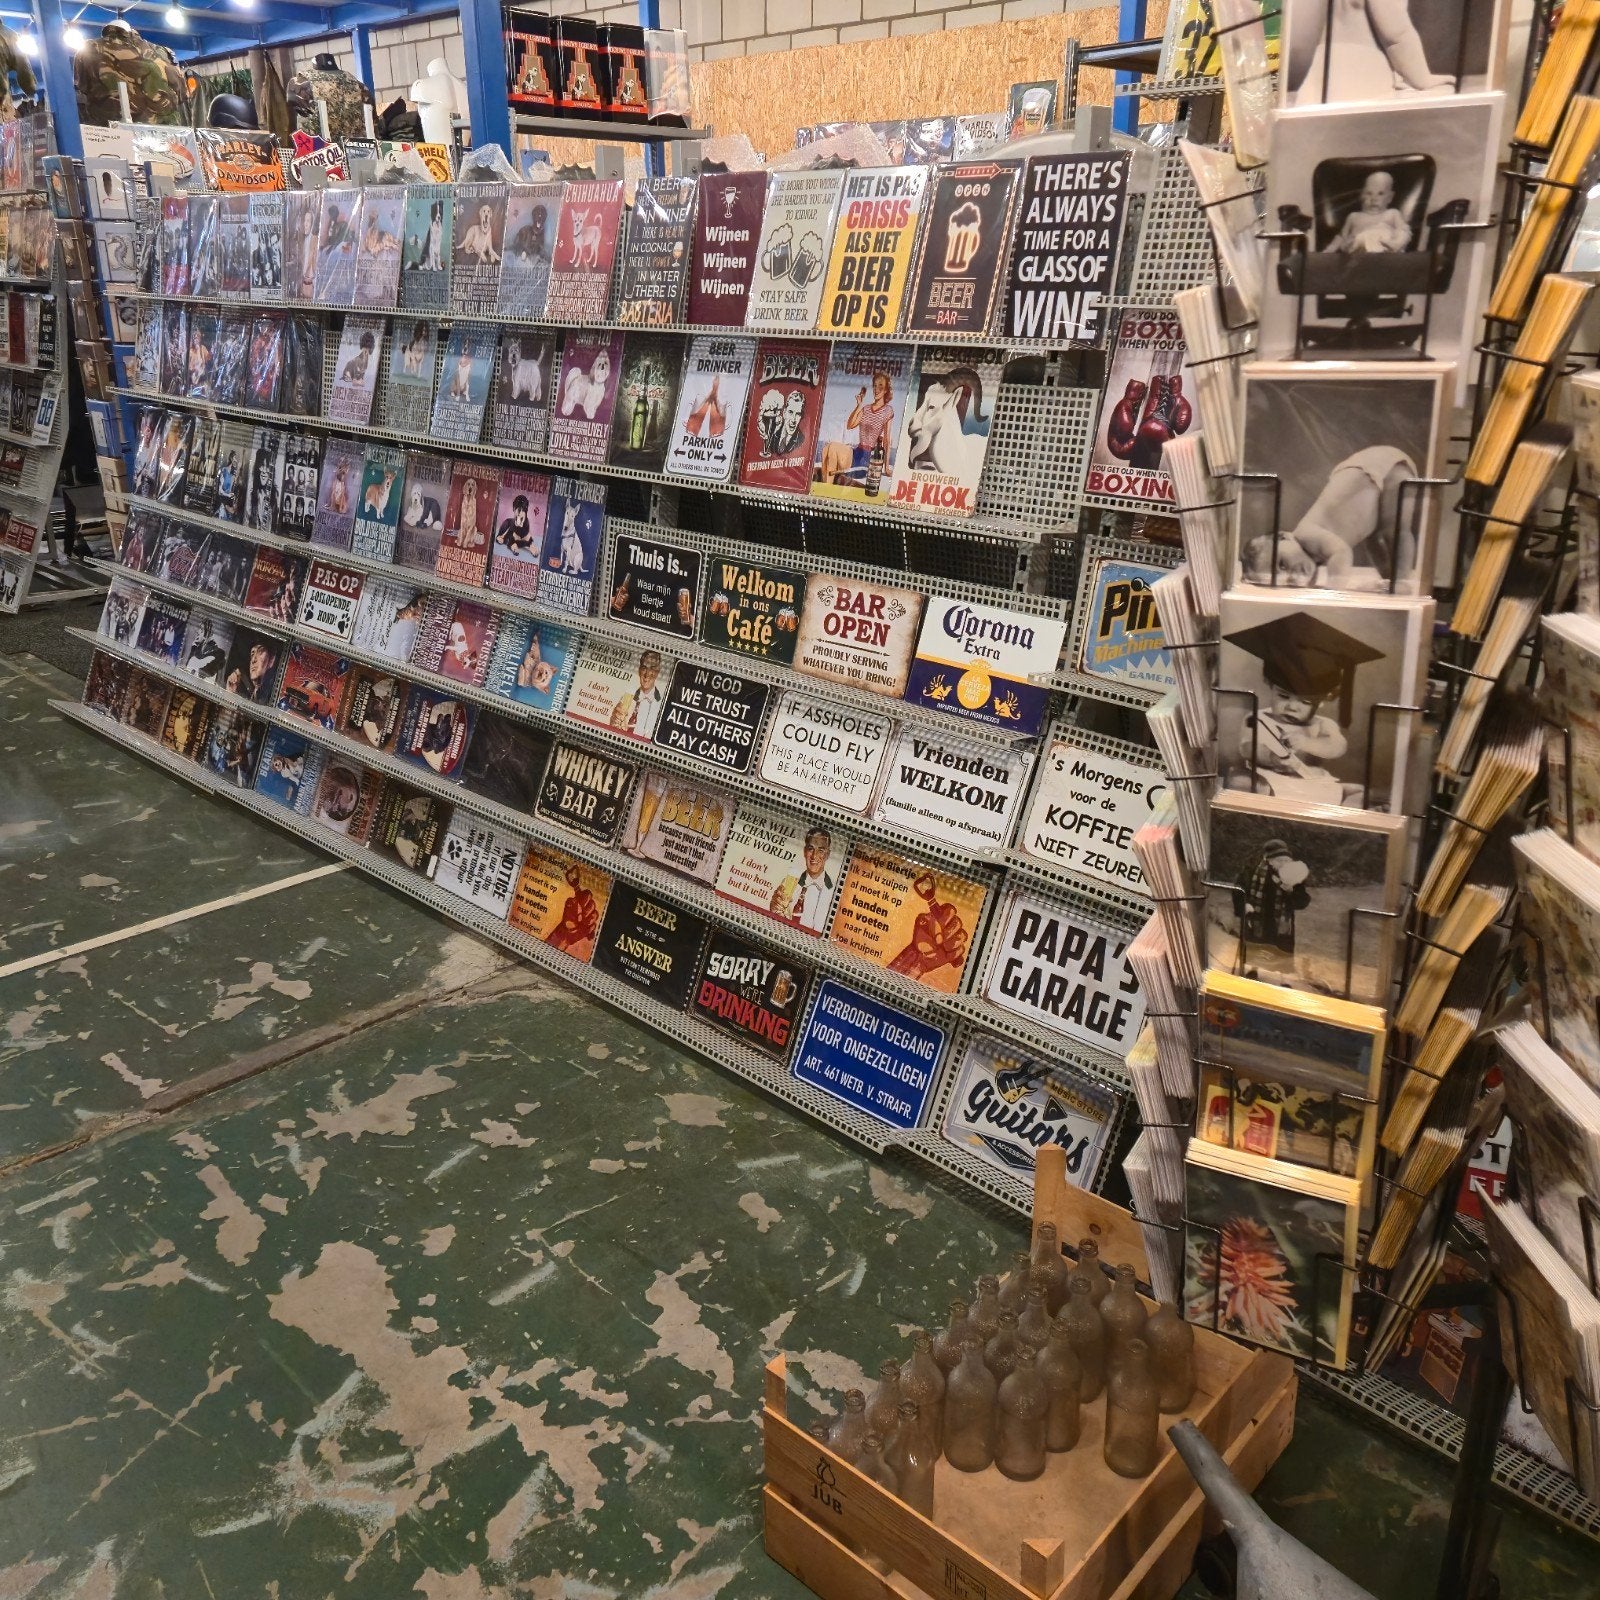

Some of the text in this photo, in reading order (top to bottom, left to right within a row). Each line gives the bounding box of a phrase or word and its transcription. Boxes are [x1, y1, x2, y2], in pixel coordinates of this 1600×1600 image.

[217, 168, 276, 185] DAVIDSON
[847, 175, 918, 198] HET IS PAS
[954, 183, 991, 198] OPEN
[1033, 160, 1125, 198] THERE'S
[564, 183, 619, 204] CHIHUAHUA
[846, 200, 911, 229] CRISIS
[1025, 195, 1118, 225] ALWAYS
[640, 240, 674, 253] COGNAC
[704, 226, 750, 247] Wijnen
[844, 232, 900, 254] ALS HET
[1023, 233, 1111, 254] TIME FOR A
[702, 252, 748, 273] Wijnen
[837, 257, 895, 292] BIER
[1018, 256, 1109, 283] GLASS OF
[649, 270, 681, 284] WATER
[700, 279, 745, 300] Wijnen
[634, 285, 666, 301] THERE
[760, 291, 808, 304] STAY SAFE
[927, 282, 977, 310] BEER
[753, 310, 809, 326] DRINK BEER
[831, 293, 888, 328] OP IS
[936, 310, 959, 325] BAR
[1013, 290, 1103, 341] WINE
[708, 342, 737, 357] BEER
[1118, 339, 1150, 351] WHEN
[696, 359, 742, 375] DRINKER
[682, 435, 725, 451] PARKING
[687, 449, 713, 462] ONLY
[576, 481, 607, 504] TERRIER
[911, 472, 960, 486] BROUWERIJ
[628, 544, 665, 572] Thuis
[314, 566, 360, 595] PAS OP
[721, 563, 794, 604] Welkom
[310, 588, 353, 613] LOSLOPENDE
[641, 593, 664, 608] Biertje
[752, 599, 770, 613] ons
[833, 586, 887, 620] BAR
[317, 609, 339, 627] HOND!
[727, 608, 773, 646] Café
[823, 612, 892, 648] OPEN
[942, 604, 1036, 652] Corona
[472, 639, 492, 685] RUSSELL
[589, 652, 626, 671] CHANGE
[812, 645, 888, 672] PROUDLY SERVING
[963, 637, 1001, 662] Extra
[580, 660, 633, 684] THE WORLD!
[694, 670, 743, 696] IN GOD
[802, 656, 897, 688] WHATEVER BRING!
[1128, 671, 1162, 684] GAME
[549, 674, 569, 715] TERRIER
[681, 687, 752, 722] WE TRUST
[667, 708, 753, 748] ALL OTHERS
[786, 700, 883, 743] IF ASSHOLES
[450, 721, 466, 761] WARNING
[669, 730, 738, 767] PAY CASH
[782, 724, 875, 765] COULD FLY
[553, 745, 631, 800] WHISKEY
[771, 744, 872, 787] THIS PLACE WOULD
[911, 738, 1011, 786] Vrienden
[776, 761, 857, 796] BE AN AIRPORT
[899, 763, 1010, 817] WELKOM
[1069, 760, 1144, 797] Morgens
[559, 784, 599, 821] BAR
[659, 786, 724, 842] BEER
[1069, 789, 1117, 812] voor de
[738, 810, 797, 839] BEER WILL
[884, 796, 1002, 843] (familie alleen op afspraak)
[1044, 803, 1135, 850] KOFFIE
[658, 821, 717, 854] Because friends
[729, 830, 798, 863] THE WORLD!
[741, 824, 787, 847] CHANGE
[1034, 833, 1080, 860] NIET
[492, 847, 519, 903] NOTICE
[729, 865, 753, 881] know
[881, 876, 909, 894] zuipen
[886, 861, 918, 883] Biertje
[522, 884, 549, 902] handen
[524, 897, 549, 914] voeten
[851, 894, 889, 918] handen
[859, 885, 903, 908] moet op
[633, 896, 678, 933] BEER
[855, 912, 890, 933] voeten
[843, 921, 881, 944] naar huis
[614, 932, 673, 975] ANSWER
[849, 938, 884, 960] kruipen!
[1011, 907, 1141, 996] PAPA'S
[706, 951, 777, 988] SORRY
[697, 979, 792, 1047] DRINKING
[999, 956, 1134, 1043] GARAGE
[821, 993, 936, 1061] VERBODEN TOEGANG
[811, 1020, 929, 1092] VOOR ONGEZELLIGEN
[803, 1054, 914, 1121] ART. 461 WETB. STRAFR.
[1050, 1082, 1105, 1123] MUSIC STORE
